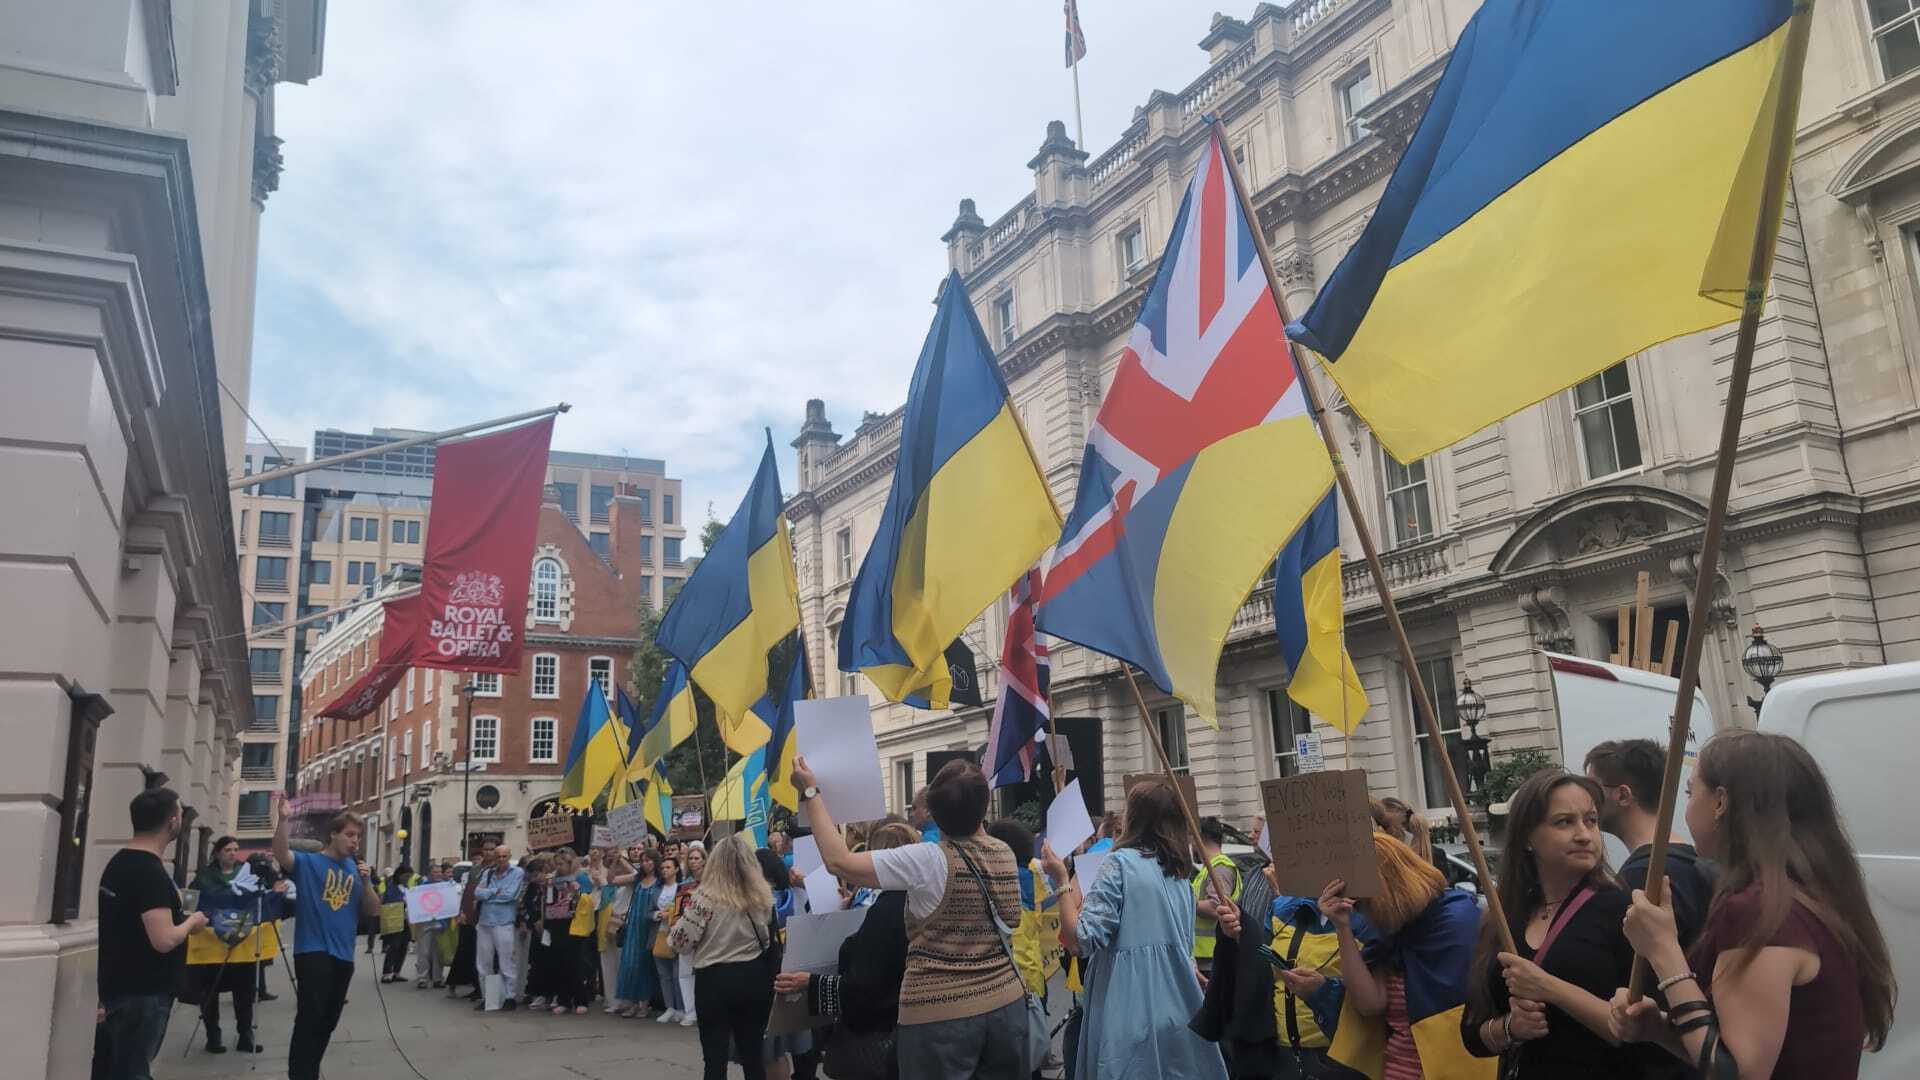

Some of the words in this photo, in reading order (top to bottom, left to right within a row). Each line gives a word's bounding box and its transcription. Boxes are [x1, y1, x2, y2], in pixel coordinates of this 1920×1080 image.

[445, 604, 505, 625] ROYAL
[430, 619, 498, 641] BALLET
[497, 624, 514, 641] &
[438, 638, 500, 658] OPERA
